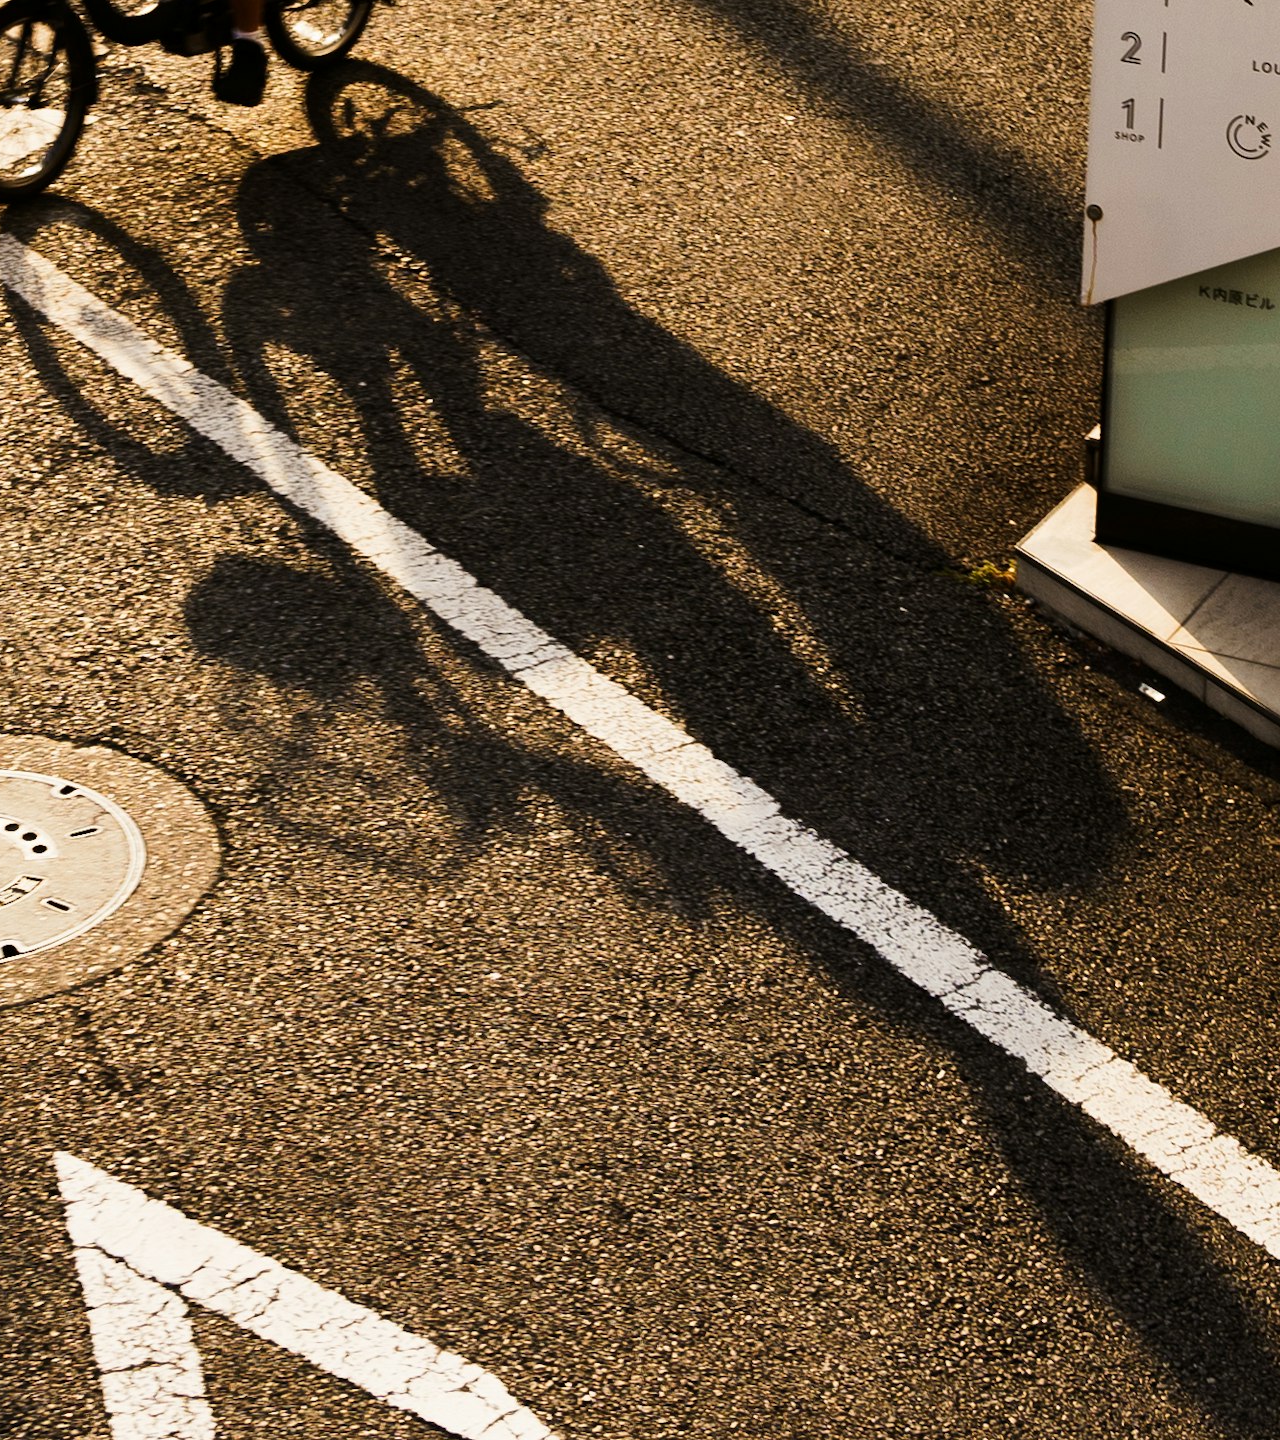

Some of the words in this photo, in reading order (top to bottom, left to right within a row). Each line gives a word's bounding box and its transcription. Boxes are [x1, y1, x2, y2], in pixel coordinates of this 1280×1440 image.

[1120, 31, 1142, 66] 2
[1121, 98, 1135, 130] 1
[1114, 130, 1146, 143] SHOP
[1198, 285, 1276, 311] K内原ビル
